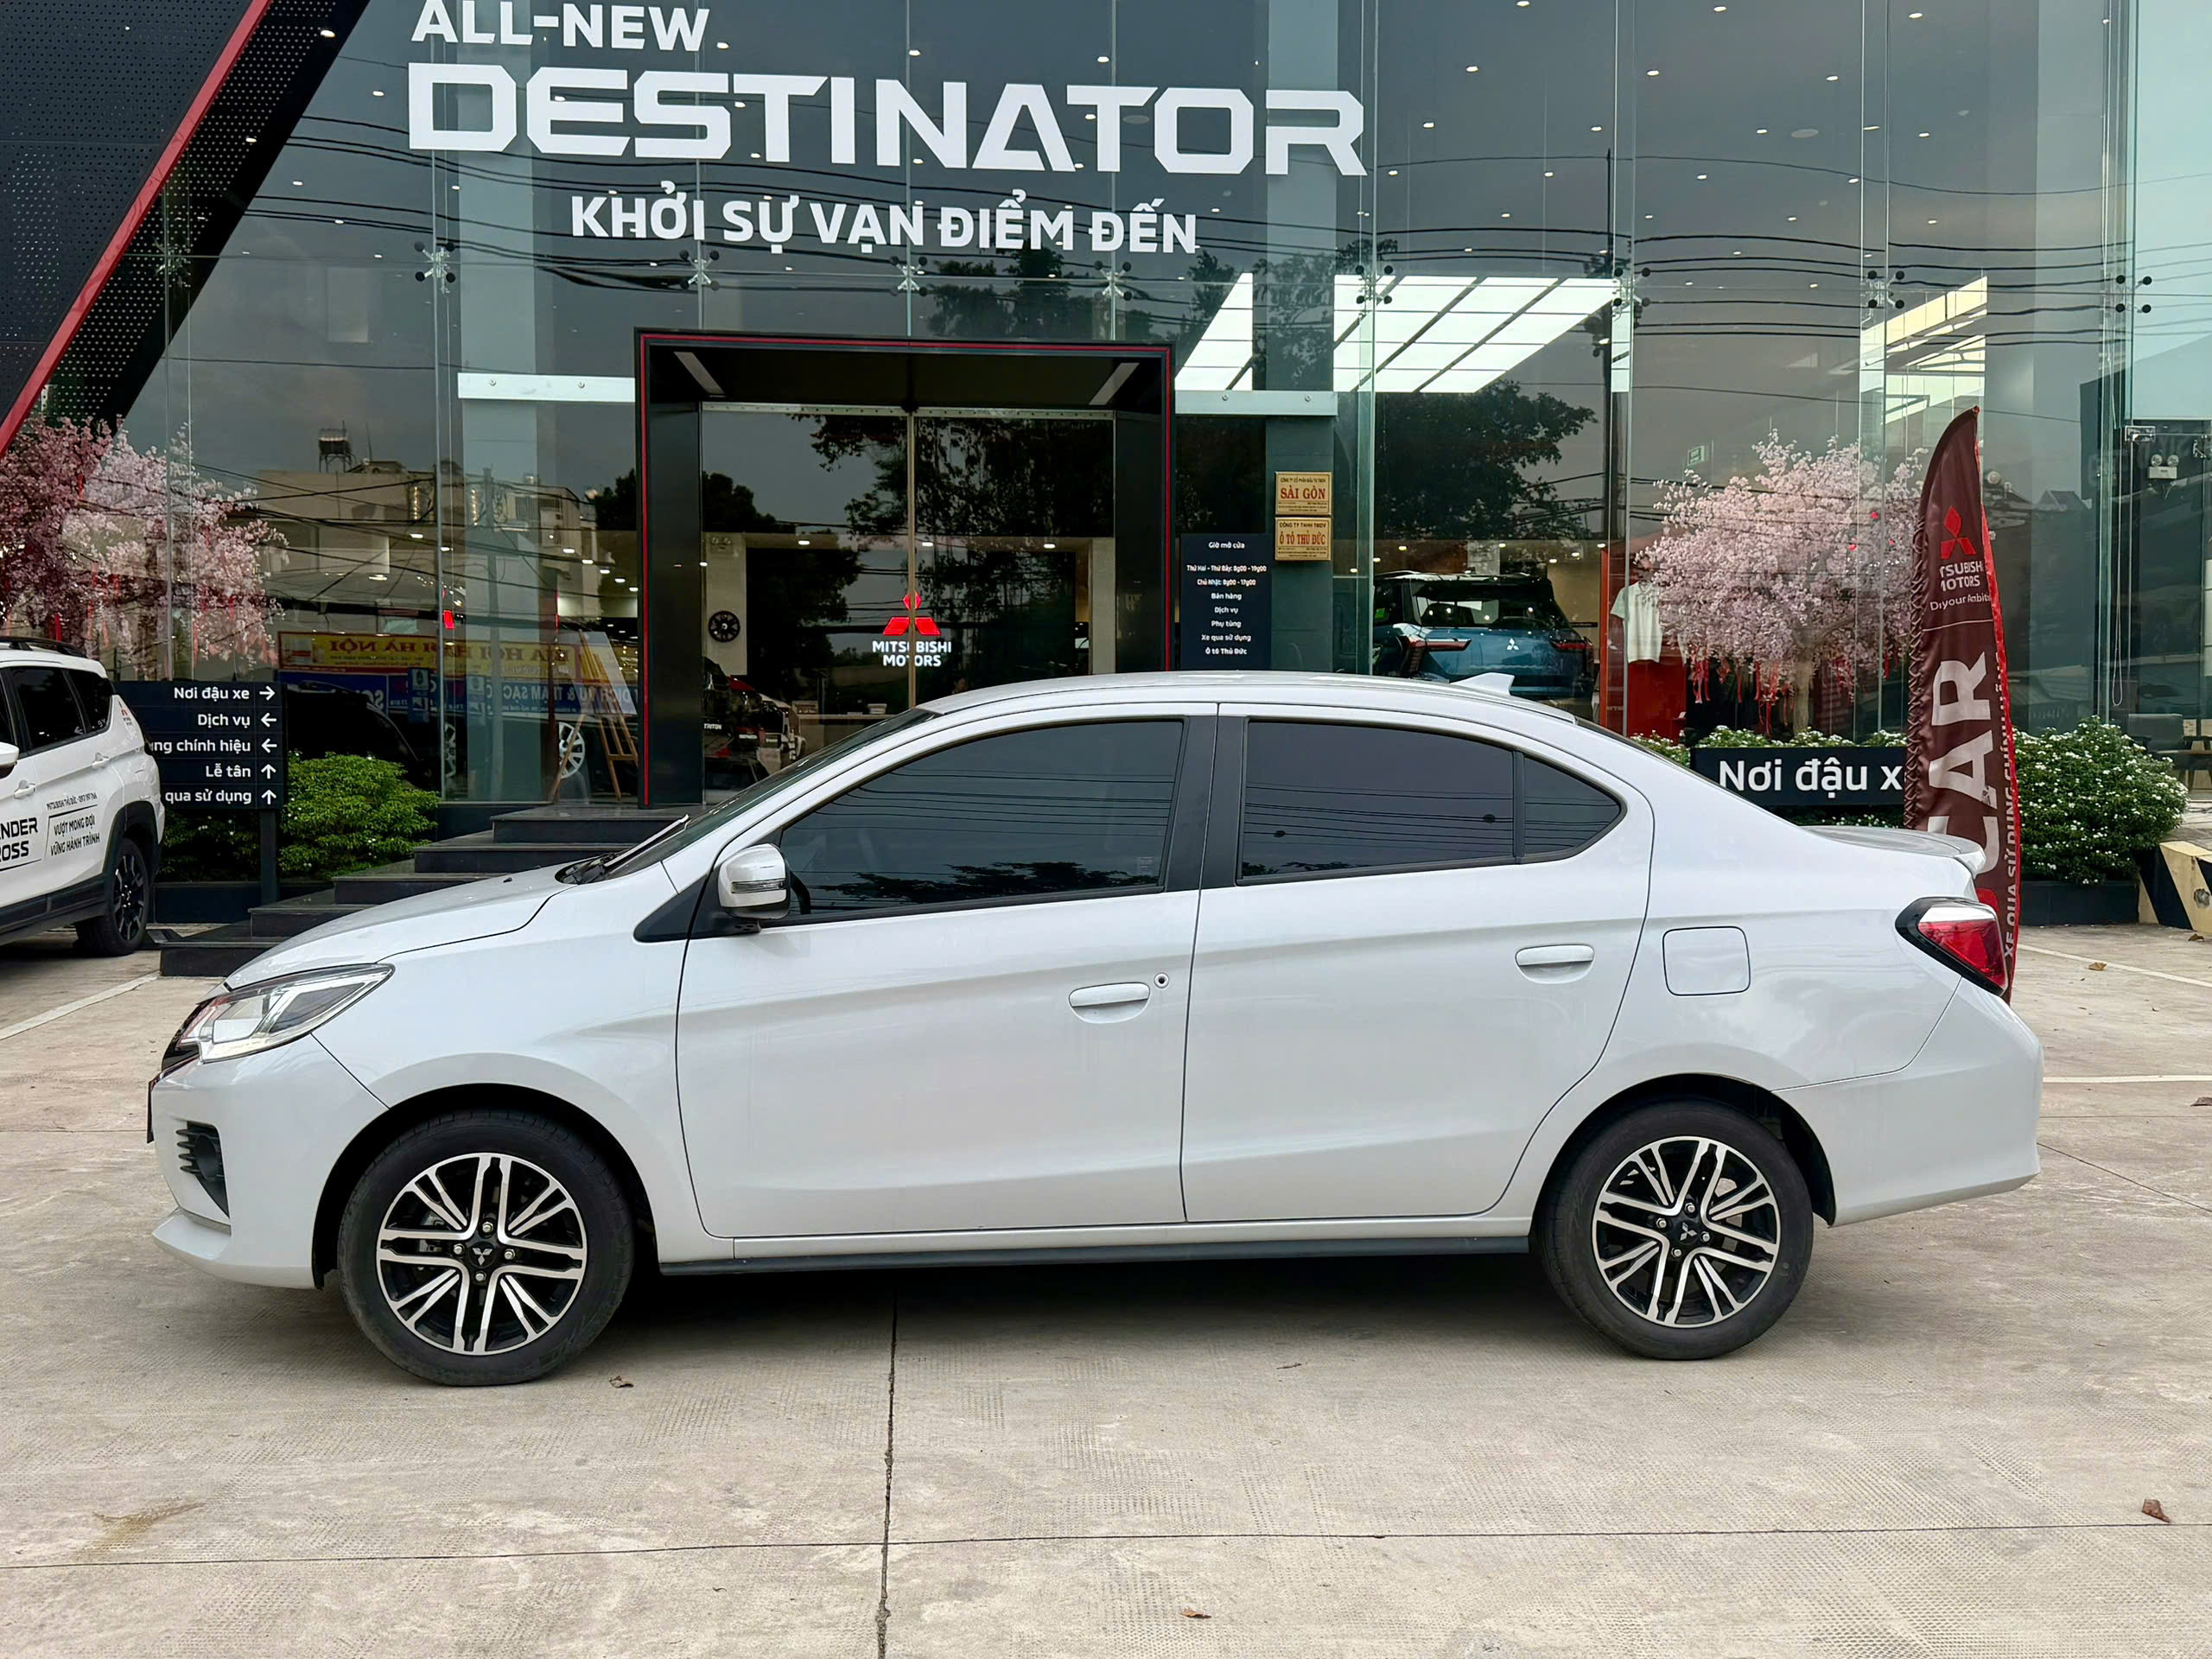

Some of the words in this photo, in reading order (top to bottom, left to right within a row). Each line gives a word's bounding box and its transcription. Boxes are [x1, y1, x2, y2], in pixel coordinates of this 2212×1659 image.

[411, 0, 710, 51] ALL-NEW
[409, 62, 1368, 175] DESTINATOR
[571, 181, 705, 240] KHỞI
[722, 194, 800, 254] SỰ
[810, 202, 924, 253] VẠN
[937, 188, 1074, 251] ĐIỂM
[1088, 198, 1197, 254] ĐẾN
[1280, 485, 1299, 499] SÀI
[1302, 485, 1325, 499] GÒN
[1279, 531, 1285, 545] Ô
[1286, 531, 1295, 545] TÔ
[1297, 530, 1311, 545] THỦ
[1312, 531, 1326, 545] ĐỨC
[872, 640, 951, 653] MITSBISHI
[883, 654, 942, 667] MOORS
[174, 686, 198, 699] Nơi
[201, 686, 229, 702] đậu
[232, 689, 250, 699] xe
[197, 713, 229, 728] Dịch
[232, 715, 251, 728] vụ
[151, 741, 173, 754] ng
[176, 739, 216, 752] chính
[219, 739, 251, 754] hiệu
[206, 762, 223, 778] Lễ
[226, 764, 251, 778] tân
[1719, 758, 1782, 791] Nơi
[1795, 756, 1868, 798] đậu
[1879, 765, 1903, 791] x
[165, 791, 191, 804] qua
[194, 788, 213, 802] sử
[215, 789, 251, 804] dụng
[0, 817, 38, 841] NDER
[68, 817, 85, 832] MONG
[0, 840, 29, 862] OSS
